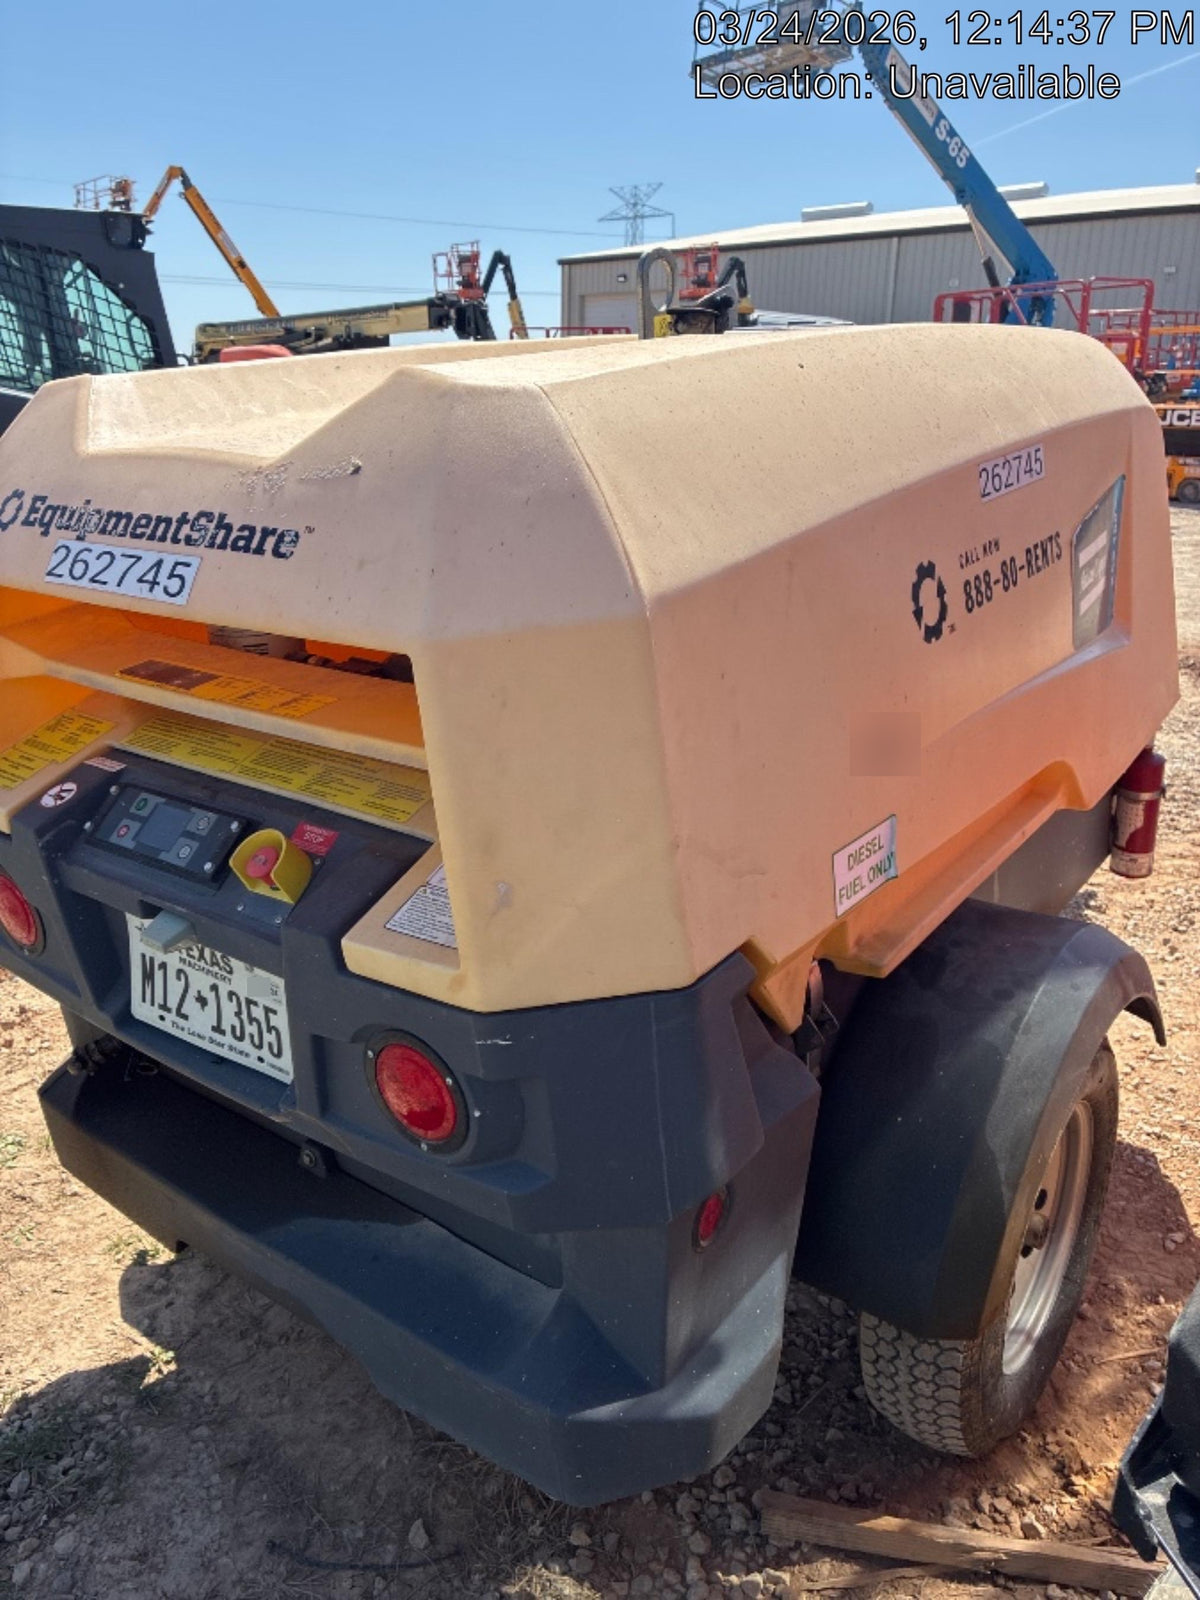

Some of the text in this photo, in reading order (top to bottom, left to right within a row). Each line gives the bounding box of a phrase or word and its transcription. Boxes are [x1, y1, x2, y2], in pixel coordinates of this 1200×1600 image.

[935, 118, 970, 168] S-65
[979, 448, 1043, 498] 262745
[20, 495, 301, 560] EquipmentShare
[45, 544, 192, 598] 262745
[959, 547, 981, 570] CALL
[963, 531, 1063, 614] 888-80-RENTS
[303, 831, 324, 843] STOP
[847, 835, 885, 871] DIESEL
[838, 851, 895, 905] FUEL ONLY
[140, 952, 284, 1060] M12 1355
